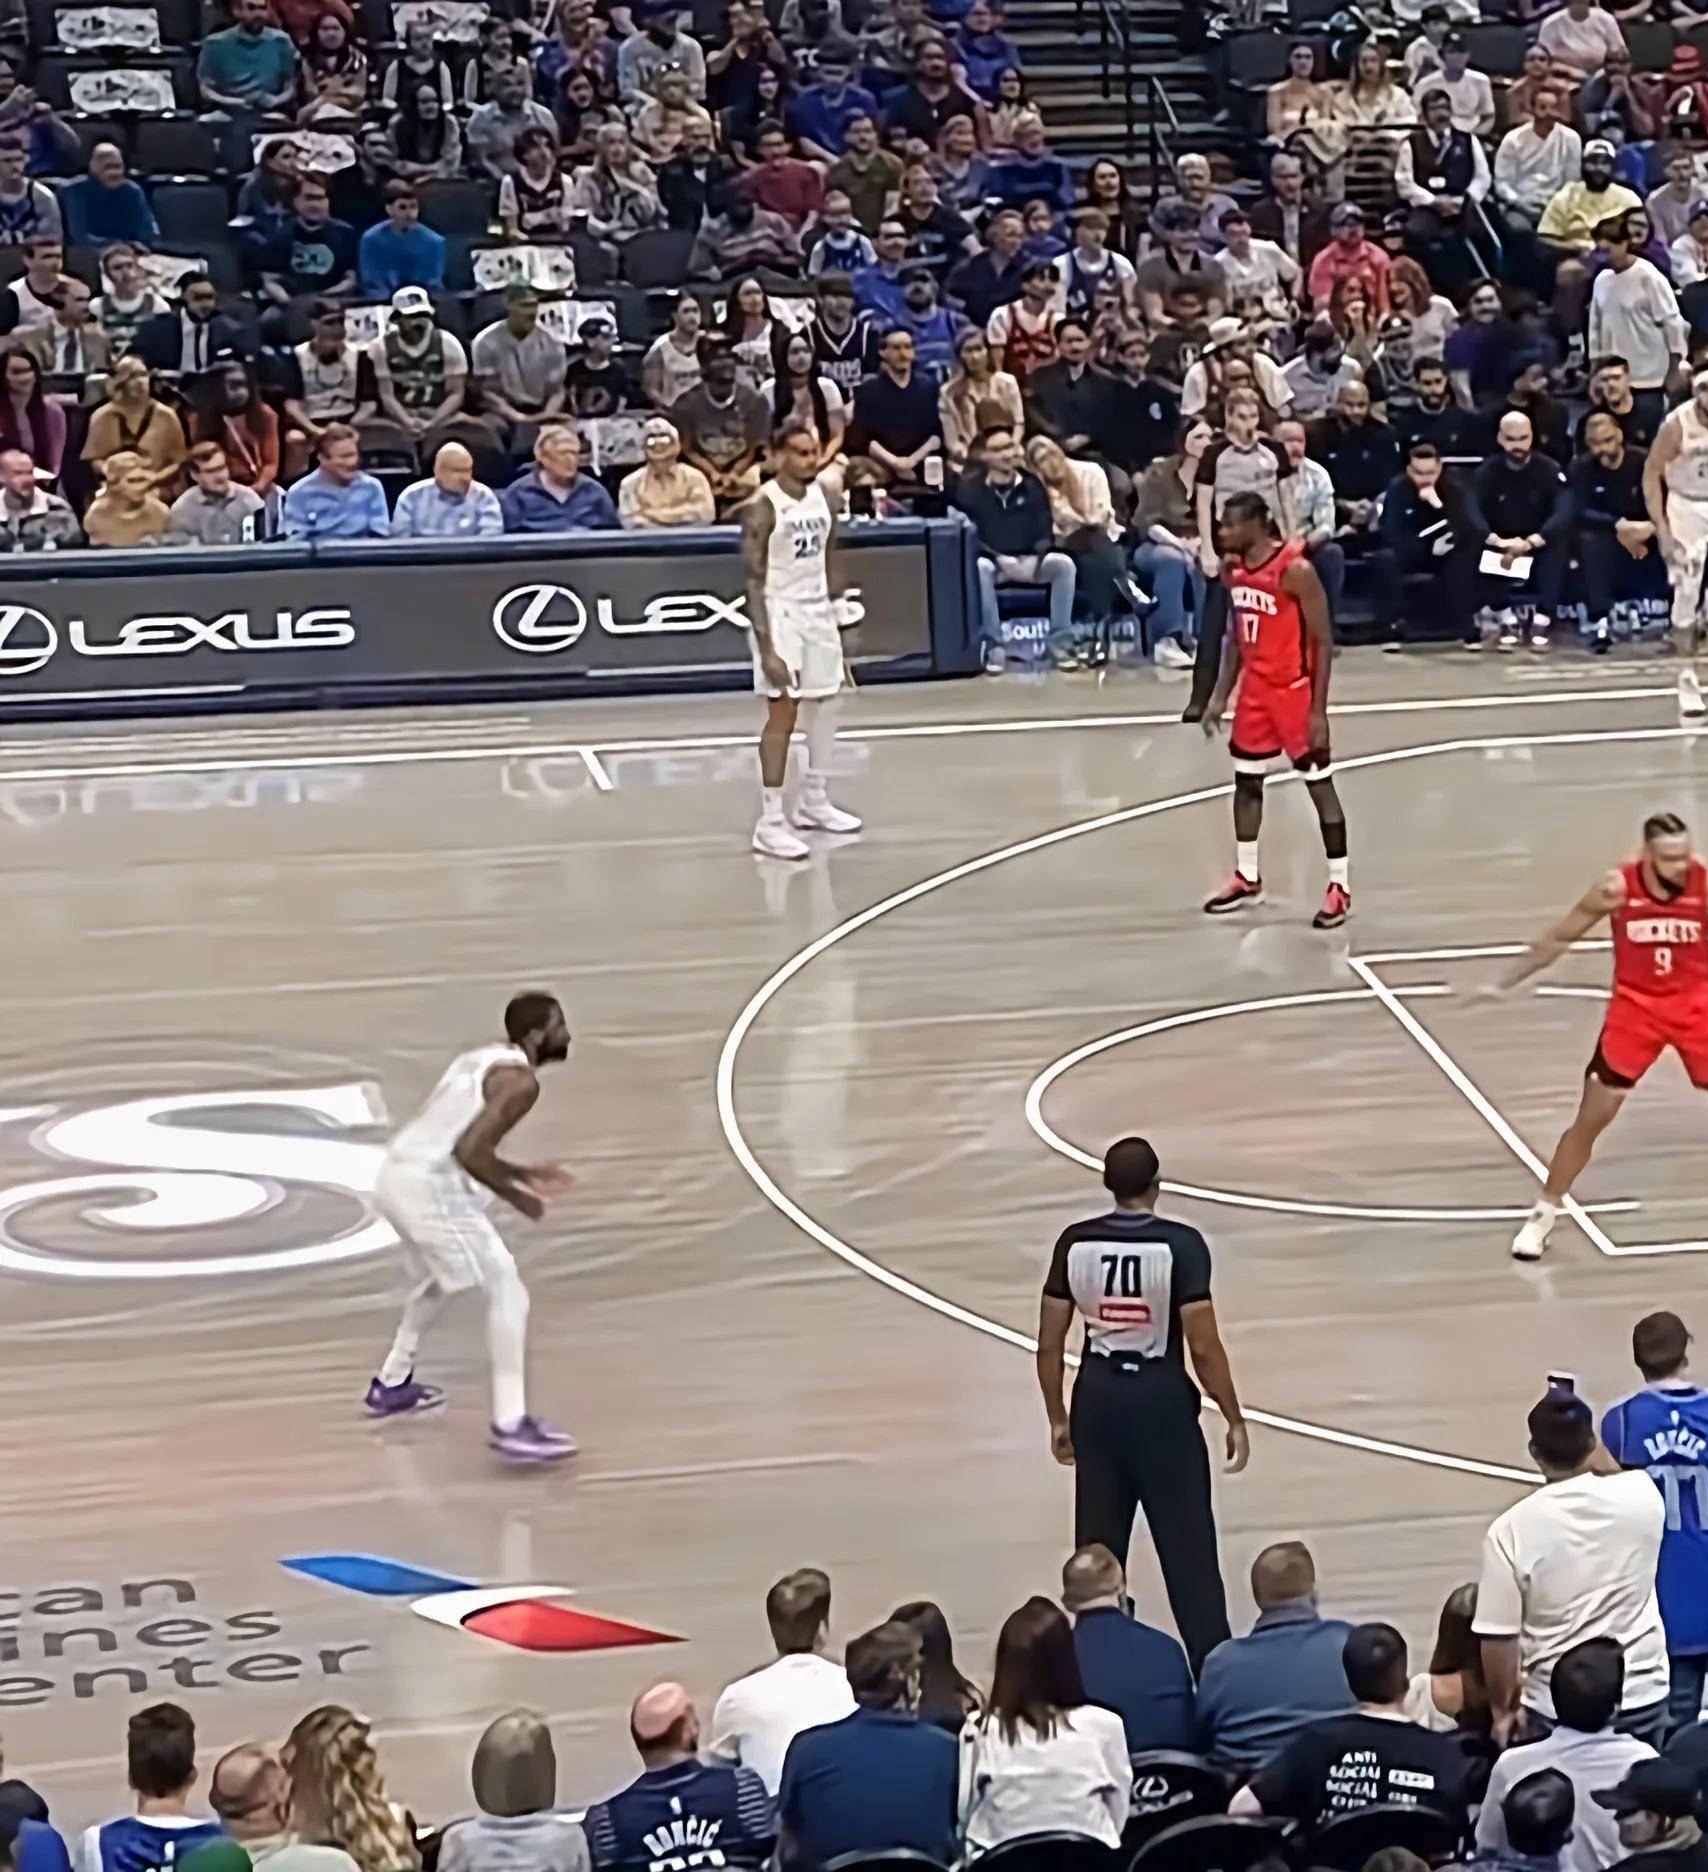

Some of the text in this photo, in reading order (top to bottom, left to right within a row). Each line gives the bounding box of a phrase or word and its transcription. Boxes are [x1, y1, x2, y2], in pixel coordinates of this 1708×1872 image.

[69, 608, 356, 656] LEXUS
[597, 588, 867, 635] LEXS
[1654, 948, 1672, 976] 9
[1100, 1254, 1142, 1298] 70
